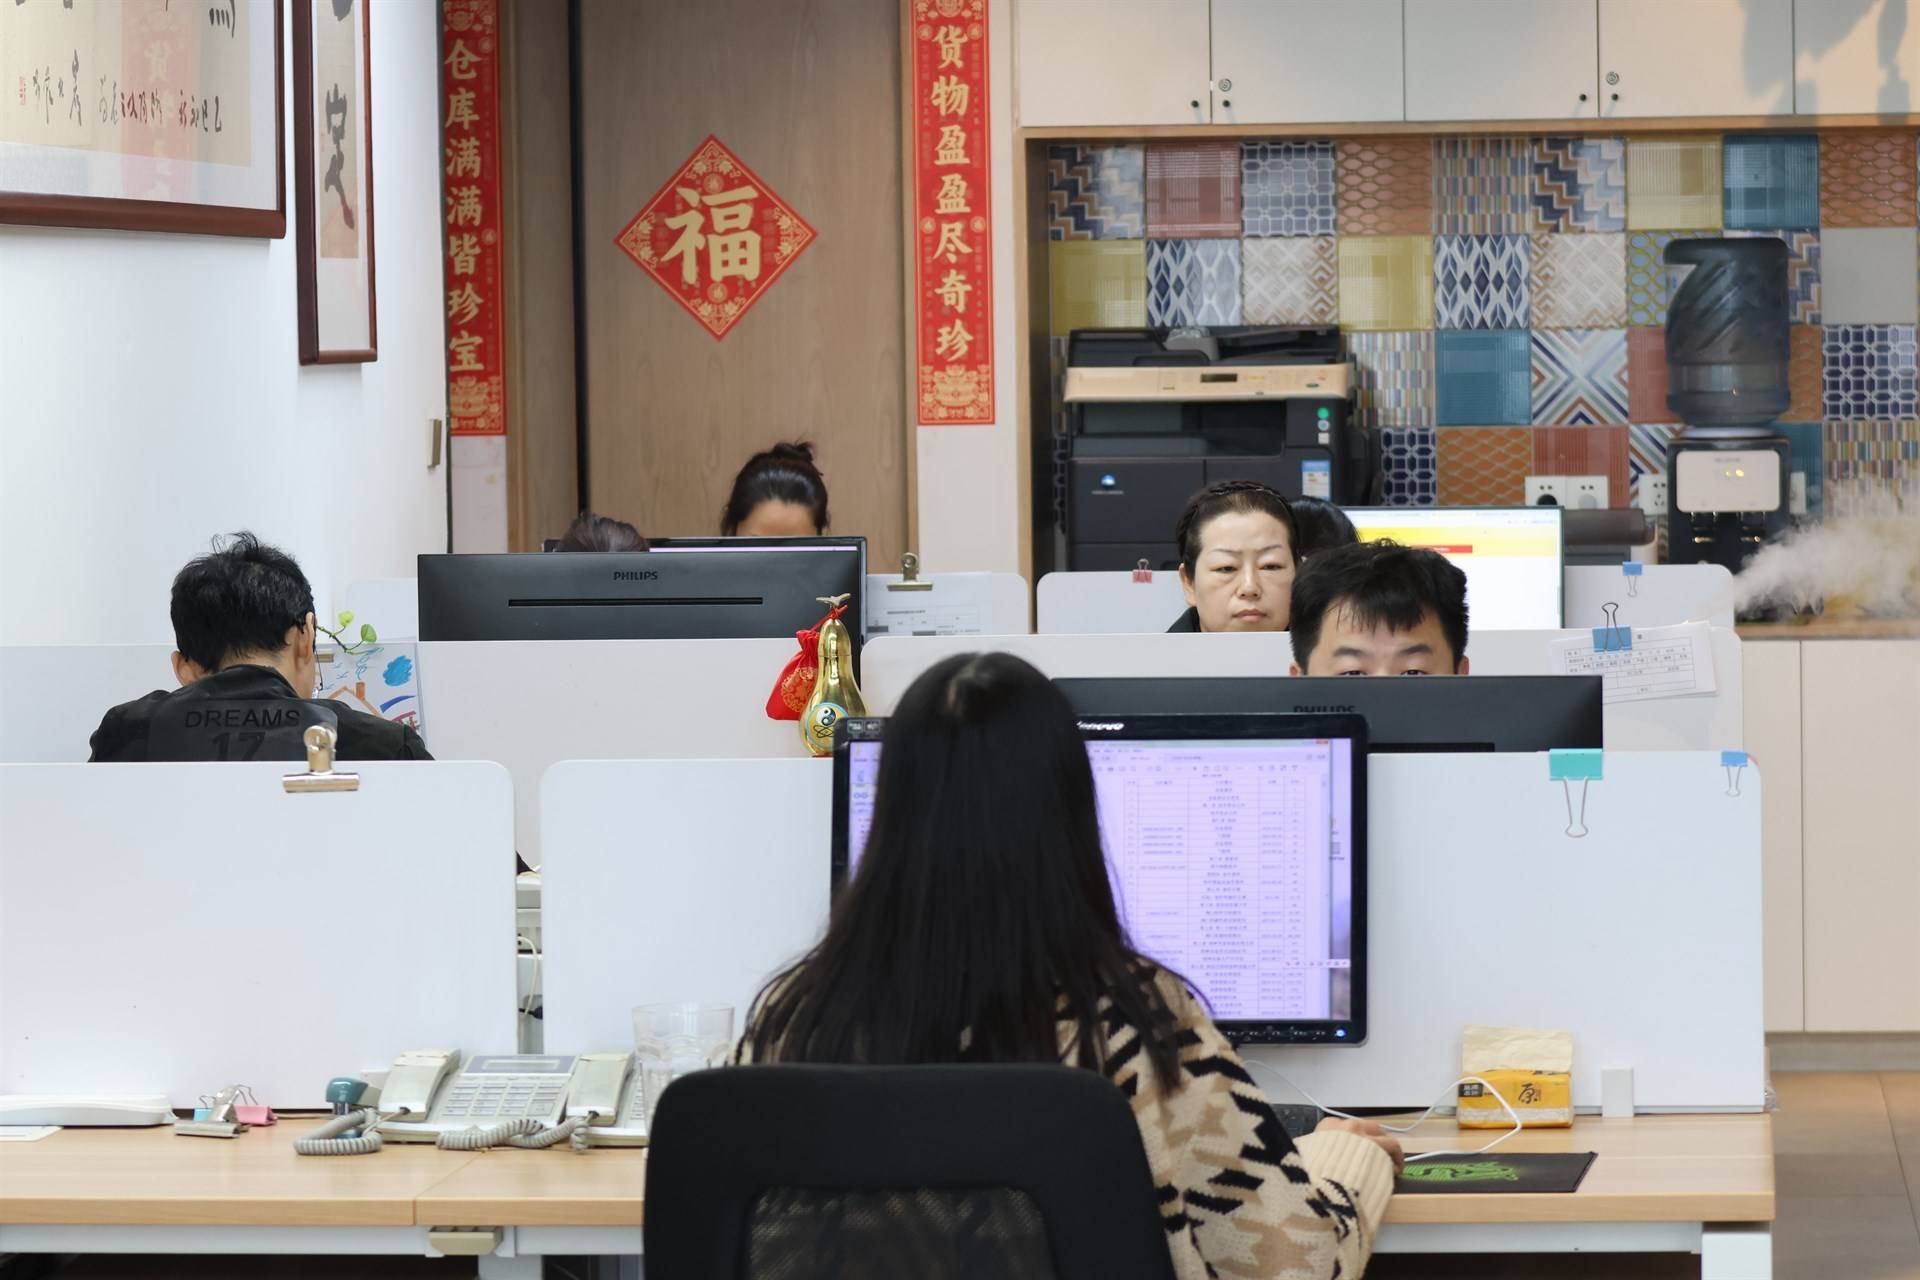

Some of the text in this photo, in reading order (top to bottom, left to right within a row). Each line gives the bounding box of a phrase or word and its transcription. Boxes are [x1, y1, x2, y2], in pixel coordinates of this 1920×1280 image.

[444, 38, 485, 372] 仓库满满皆珍宝
[930, 25, 974, 361] 货物盈盈尽奇珍
[660, 185, 759, 285] 福
[613, 571, 658, 580] PHILIPS
[185, 709, 300, 729] DREAMS
[212, 731, 265, 761] 17
